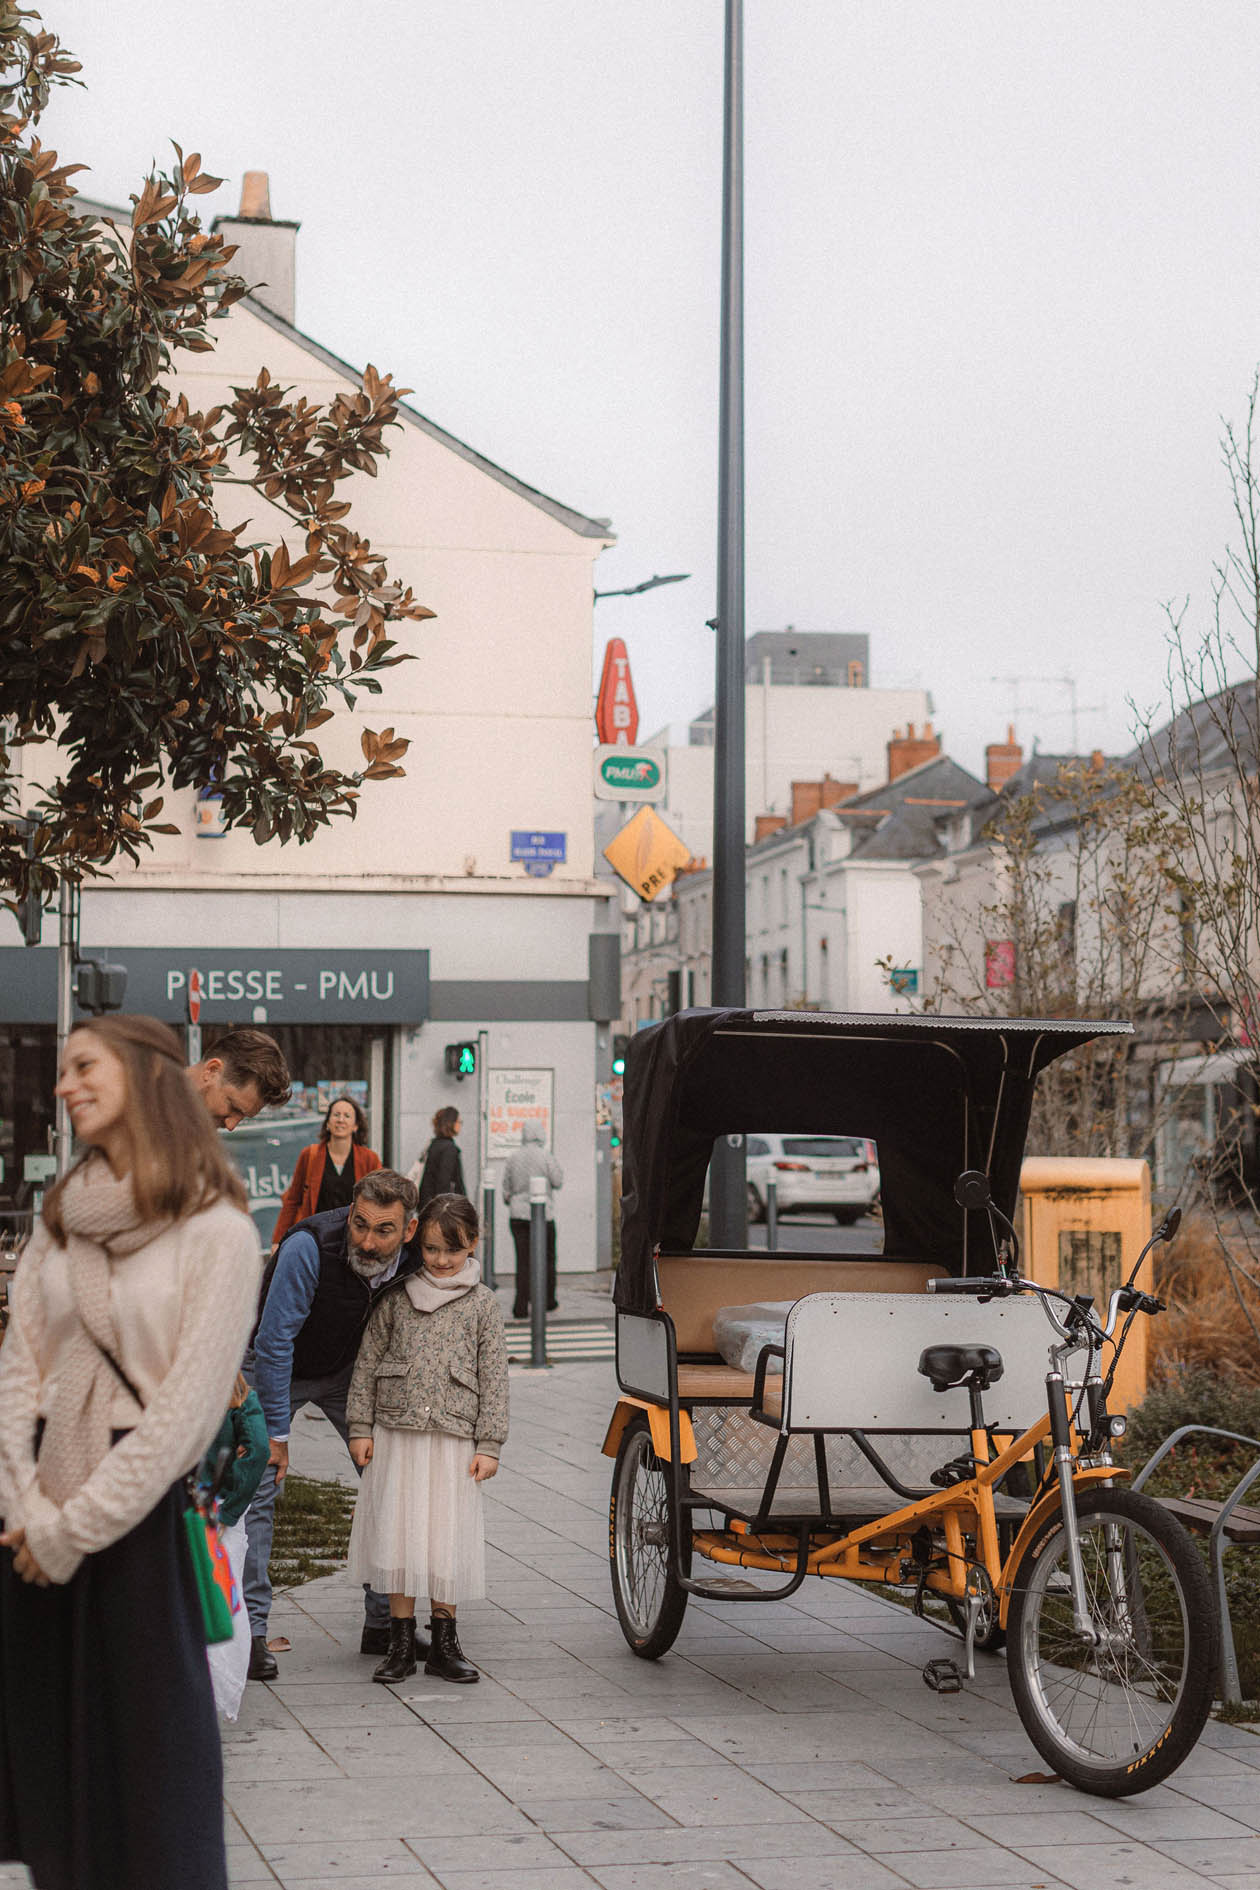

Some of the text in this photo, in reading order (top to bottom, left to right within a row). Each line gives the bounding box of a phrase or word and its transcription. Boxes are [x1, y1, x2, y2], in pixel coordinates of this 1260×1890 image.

[613, 658, 632, 745] TABA
[606, 766, 636, 779] PMU
[167, 970, 283, 1000] PRESSE
[319, 970, 394, 1000] PMU
[1127, 1723, 1172, 1774] MAXXIS
